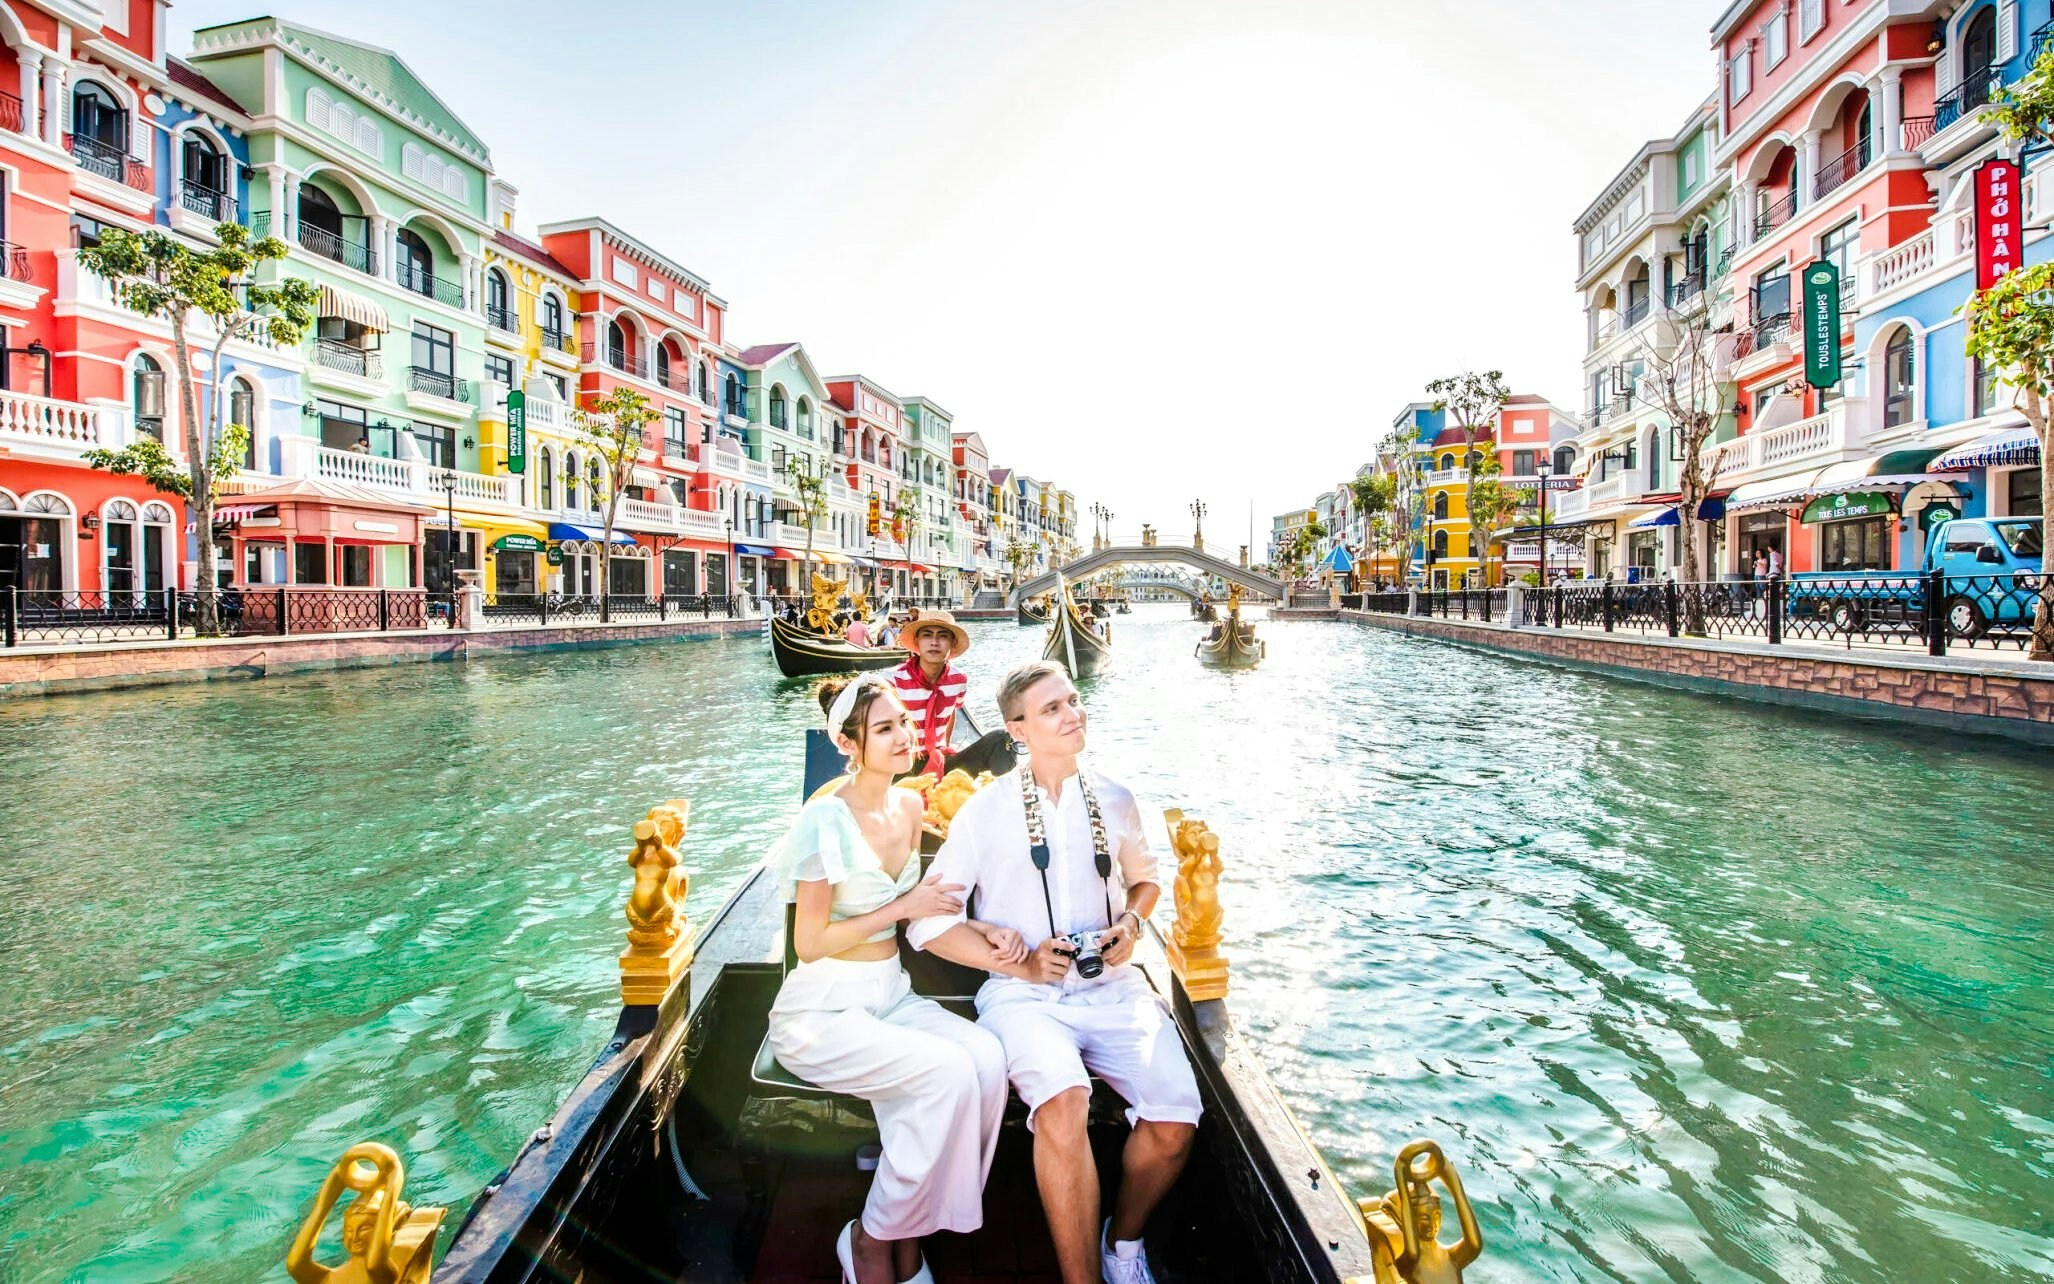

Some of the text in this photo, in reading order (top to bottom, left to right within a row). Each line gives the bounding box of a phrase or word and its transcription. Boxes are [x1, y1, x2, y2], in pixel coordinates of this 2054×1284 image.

[1991, 167, 2008, 217] PHỞ
[1817, 293, 1829, 369] TOUSLESTEMPS
[1515, 481, 1570, 489] LOTTERIA
[1818, 505, 1868, 519] TOUS LES TEMPS
[506, 537, 525, 545] POWER
